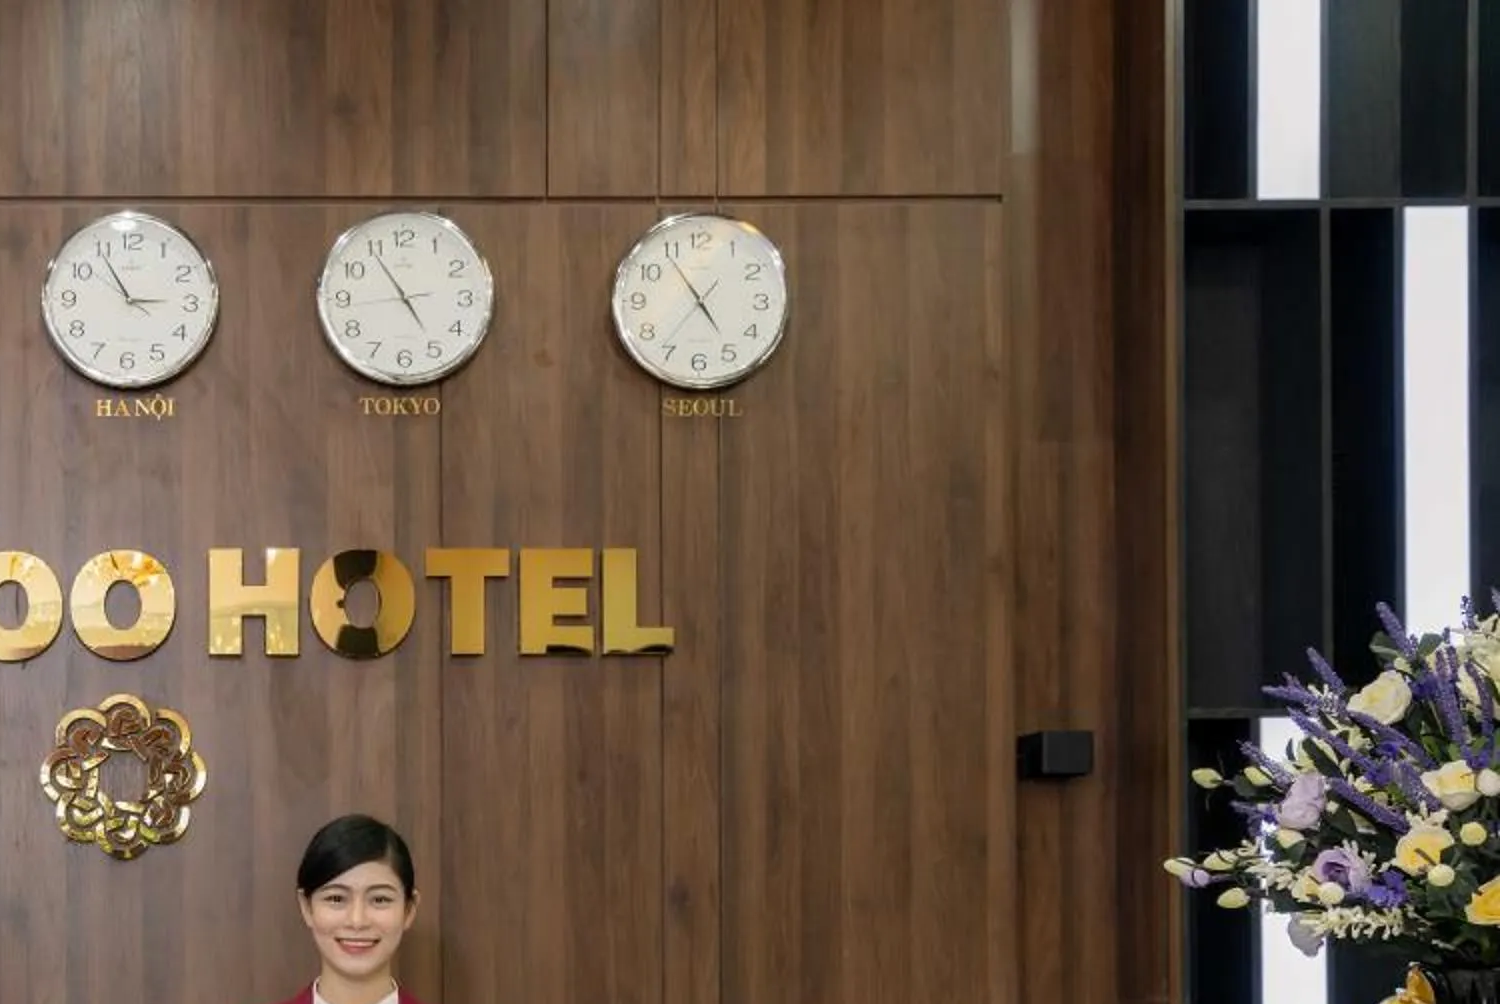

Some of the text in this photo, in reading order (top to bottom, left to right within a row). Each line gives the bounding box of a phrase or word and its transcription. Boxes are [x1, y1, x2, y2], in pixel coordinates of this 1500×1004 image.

[122, 233, 143, 250] 12
[394, 230, 415, 248] 12
[432, 237, 438, 254] 1
[691, 232, 711, 248] 12
[96, 241, 111, 259] 11
[160, 240, 168, 258] 1
[367, 240, 383, 258] 11
[664, 242, 679, 259] 11
[729, 240, 735, 257] 1
[73, 263, 92, 281] 10
[175, 266, 191, 282] 2
[345, 261, 365, 279] 10
[449, 260, 464, 278] 2
[641, 264, 662, 282] 10
[745, 264, 760, 280] 2
[62, 290, 76, 308] 9
[183, 294, 198, 312] 3
[336, 290, 351, 308] 9
[457, 290, 473, 307] 3
[631, 292, 646, 310] 9
[753, 294, 769, 310] 3
[69, 320, 84, 338] 8
[171, 323, 187, 342] 4
[345, 320, 360, 337] 8
[447, 319, 463, 337] 4
[639, 324, 655, 340] 8
[743, 323, 758, 340] 4
[92, 342, 106, 360] 7
[149, 343, 165, 362] 5
[367, 341, 383, 359] 7
[396, 350, 412, 368] 6
[426, 340, 443, 360] 5
[661, 344, 677, 362] 7
[720, 343, 737, 363] 5
[120, 352, 135, 369] 6
[691, 354, 707, 371] 6
[359, 398, 441, 416] TOKYO
[662, 399, 743, 417] SEOUL
[208, 548, 675, 659] HOTEL
